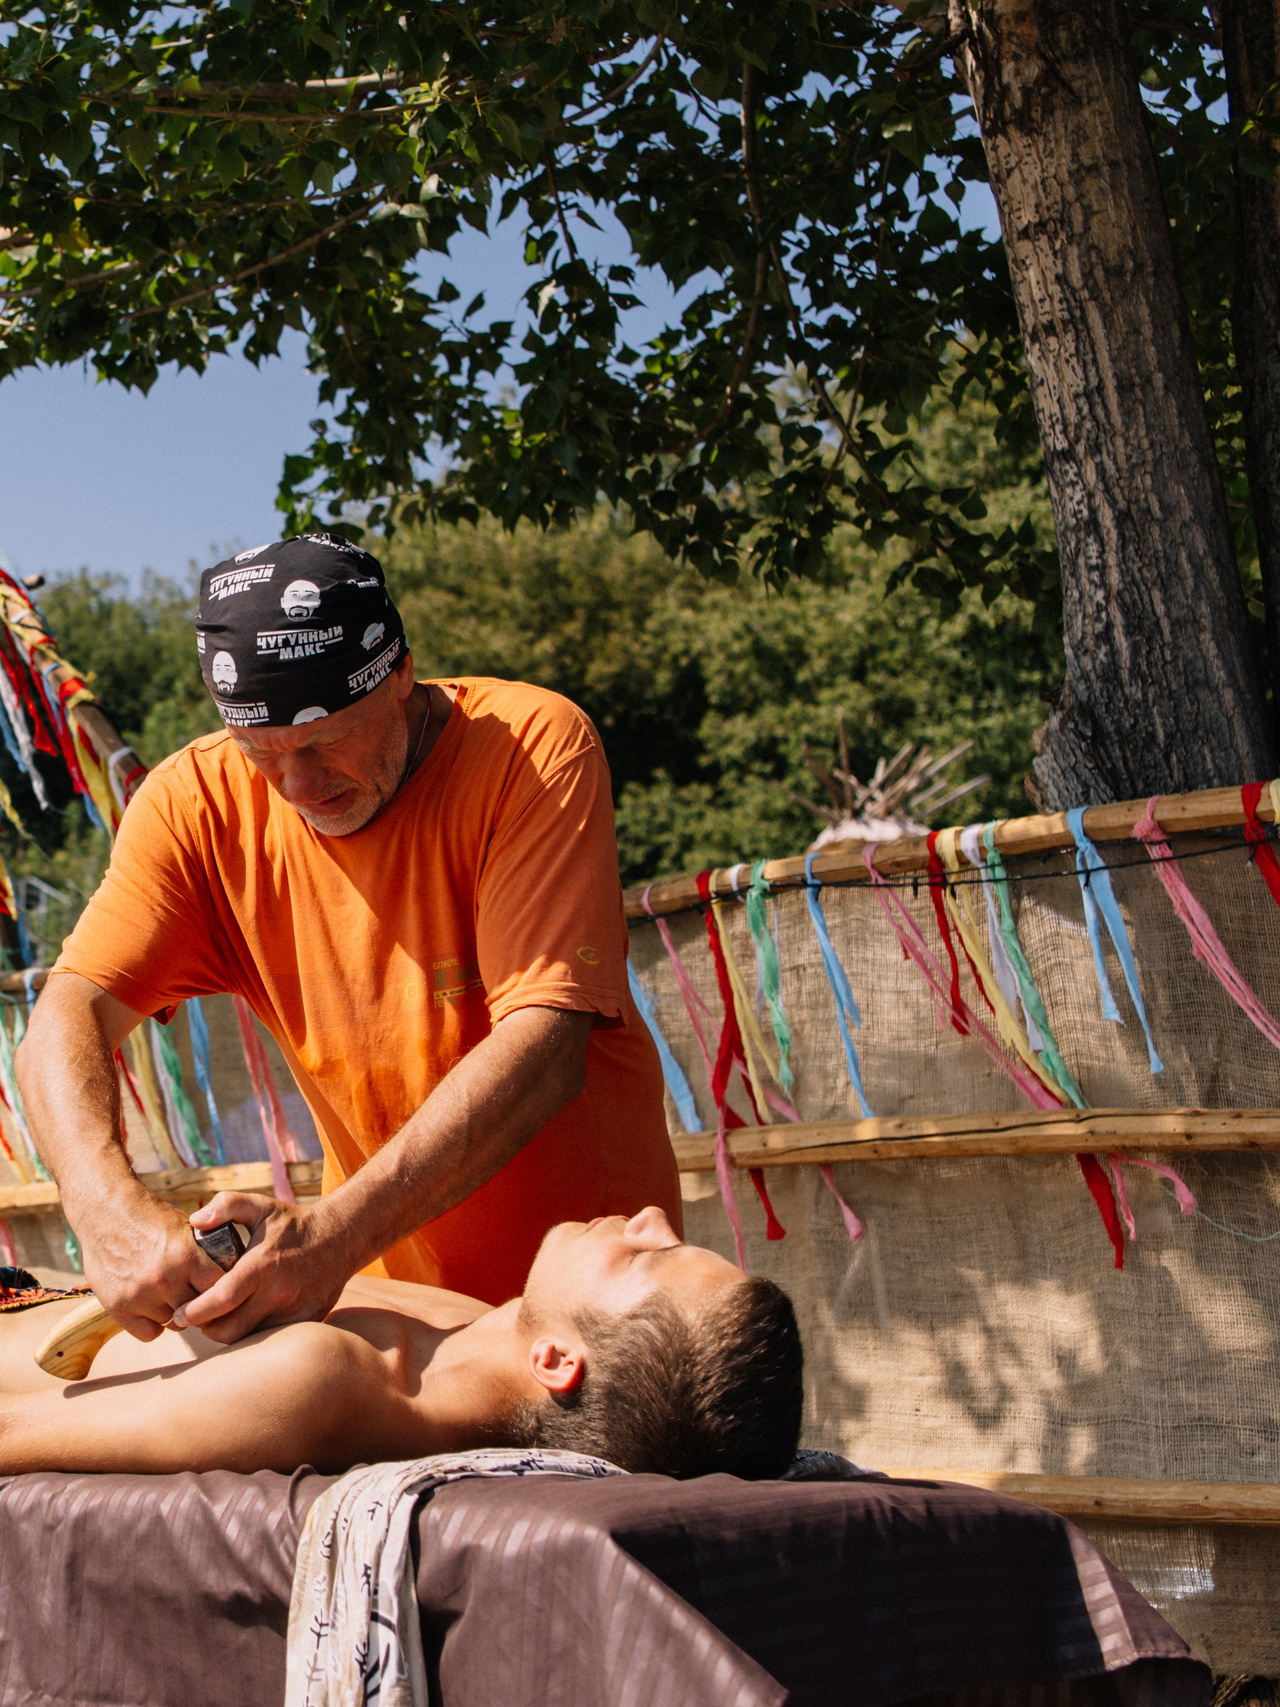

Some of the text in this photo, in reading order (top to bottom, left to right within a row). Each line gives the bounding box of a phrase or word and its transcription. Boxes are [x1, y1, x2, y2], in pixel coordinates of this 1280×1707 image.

[209, 564, 276, 594] ЧУГУННЫЙ
[218, 580, 252, 601] МАКС
[279, 641, 326, 660] МАКС
[366, 662, 392, 692] МАКС
